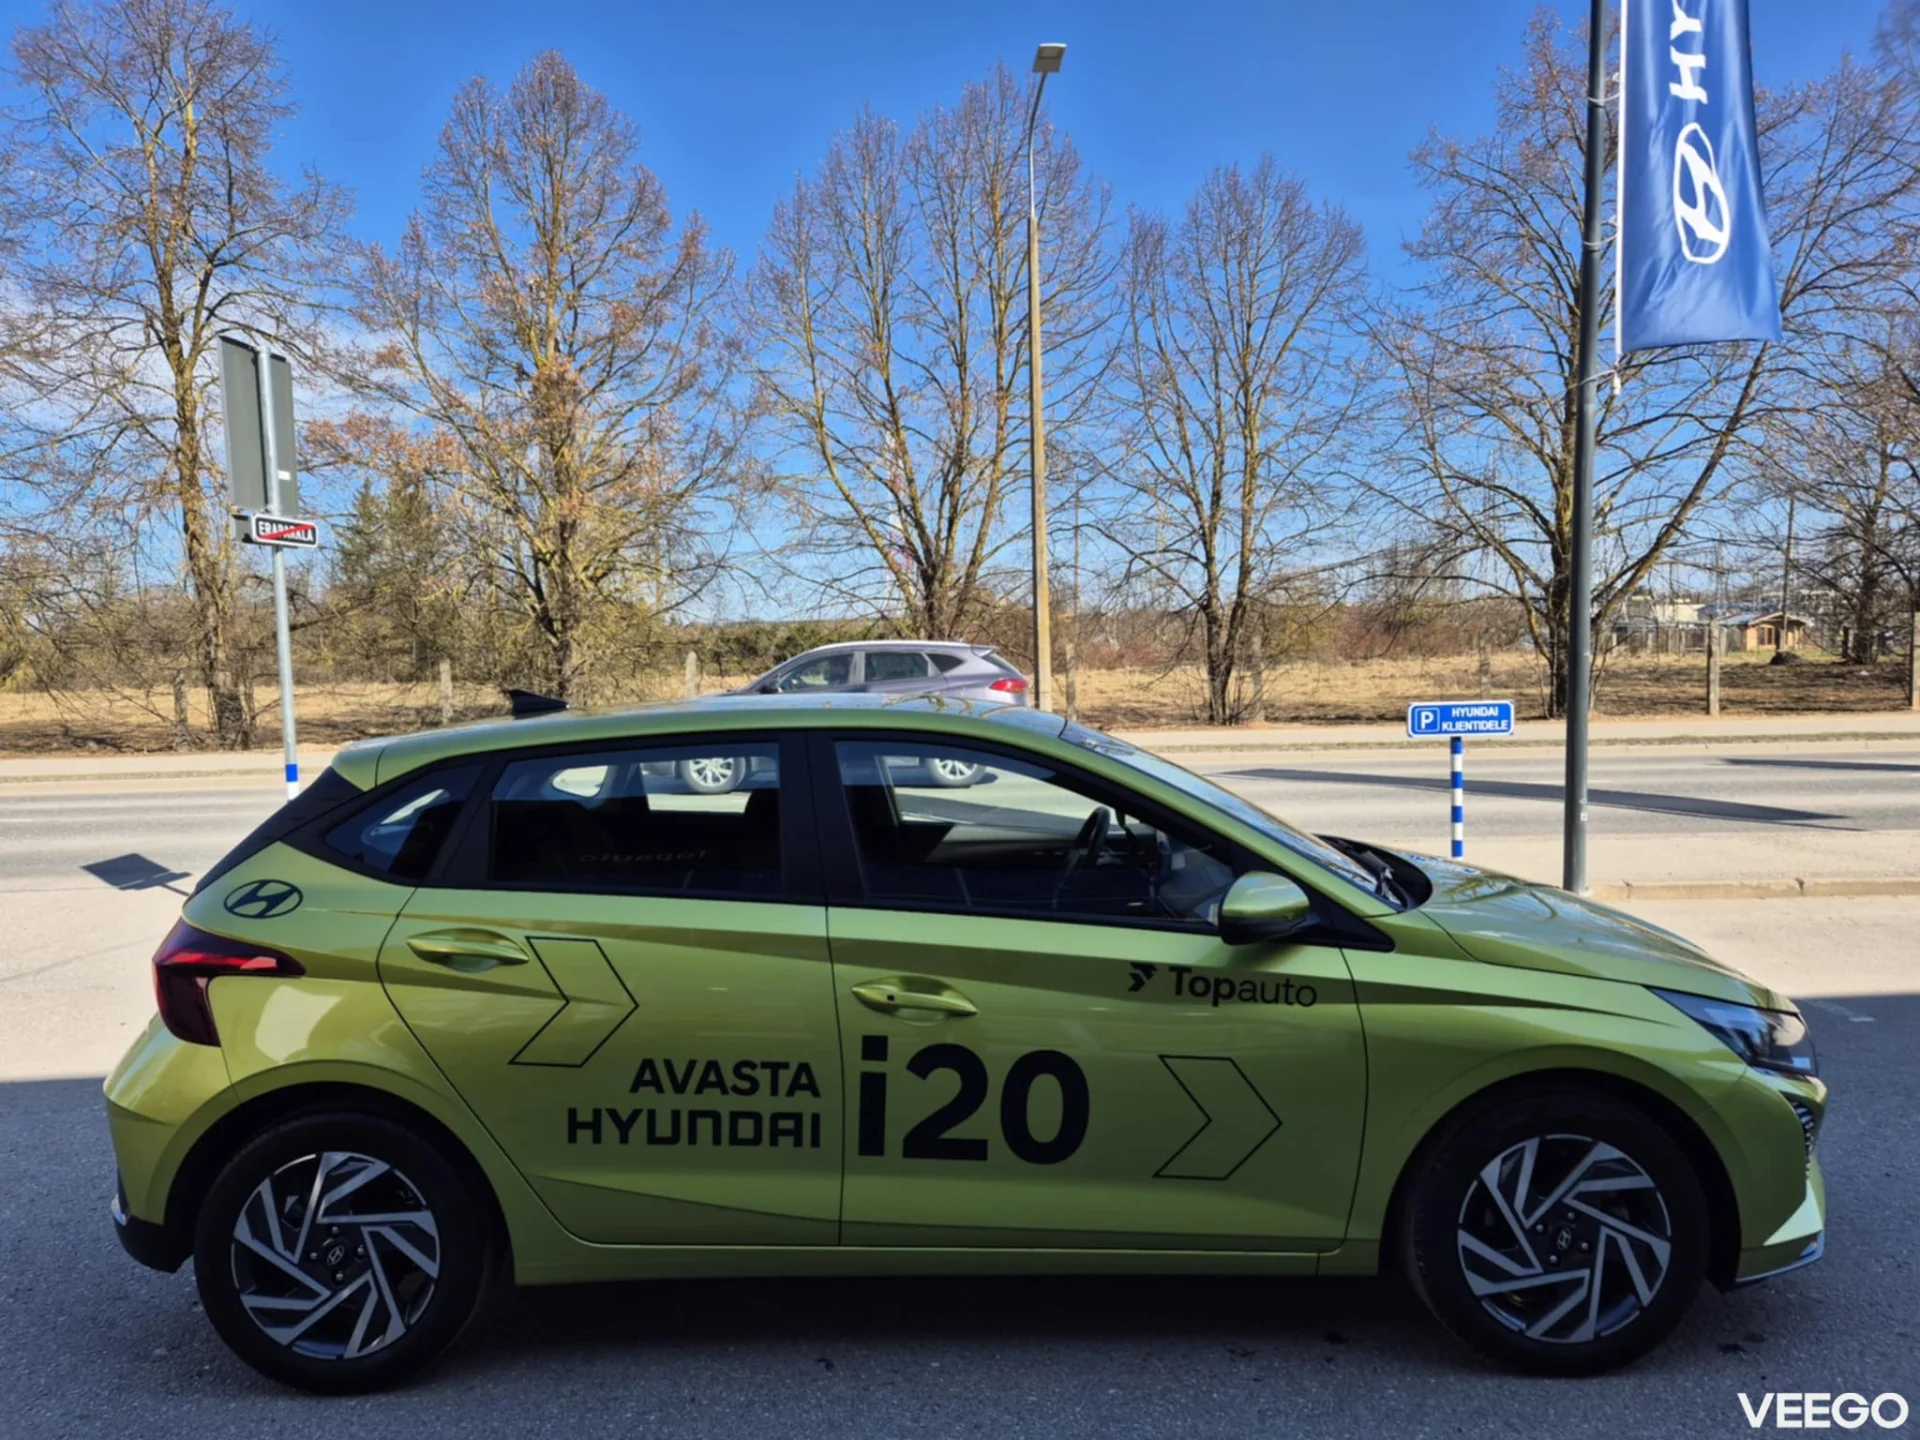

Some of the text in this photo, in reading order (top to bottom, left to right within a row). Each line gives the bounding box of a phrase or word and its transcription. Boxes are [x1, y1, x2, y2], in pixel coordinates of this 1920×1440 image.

[1420, 711, 1434, 730] P
[1442, 719, 1509, 732] KLIENTIDELE
[1452, 706, 1499, 718] HYUNDAI
[1168, 965, 1317, 1007] Topauto
[629, 1058, 821, 1098] AVASTA
[858, 1035, 1090, 1166] i20
[567, 1107, 821, 1148] HYUNDAI
